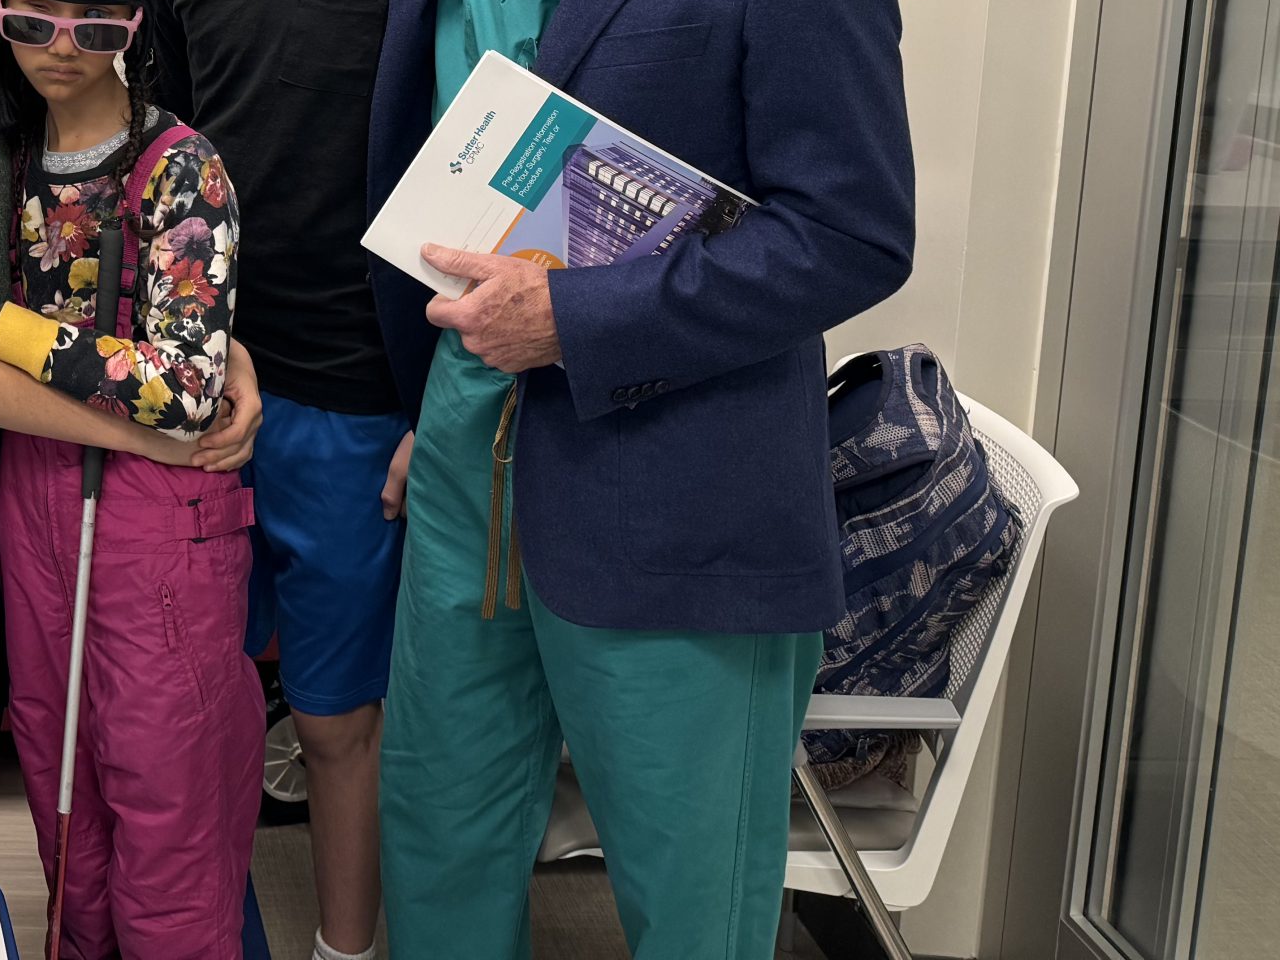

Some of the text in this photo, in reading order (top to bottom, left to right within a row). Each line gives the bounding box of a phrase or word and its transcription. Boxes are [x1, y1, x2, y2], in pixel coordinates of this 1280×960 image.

[458, 110, 496, 160] Sutter Health
[466, 141, 485, 165] CPMC
[502, 109, 559, 187] Pre-Registration Information
[510, 124, 560, 192] for Your Surgery, Test or
[518, 167, 543, 197] Procedure
